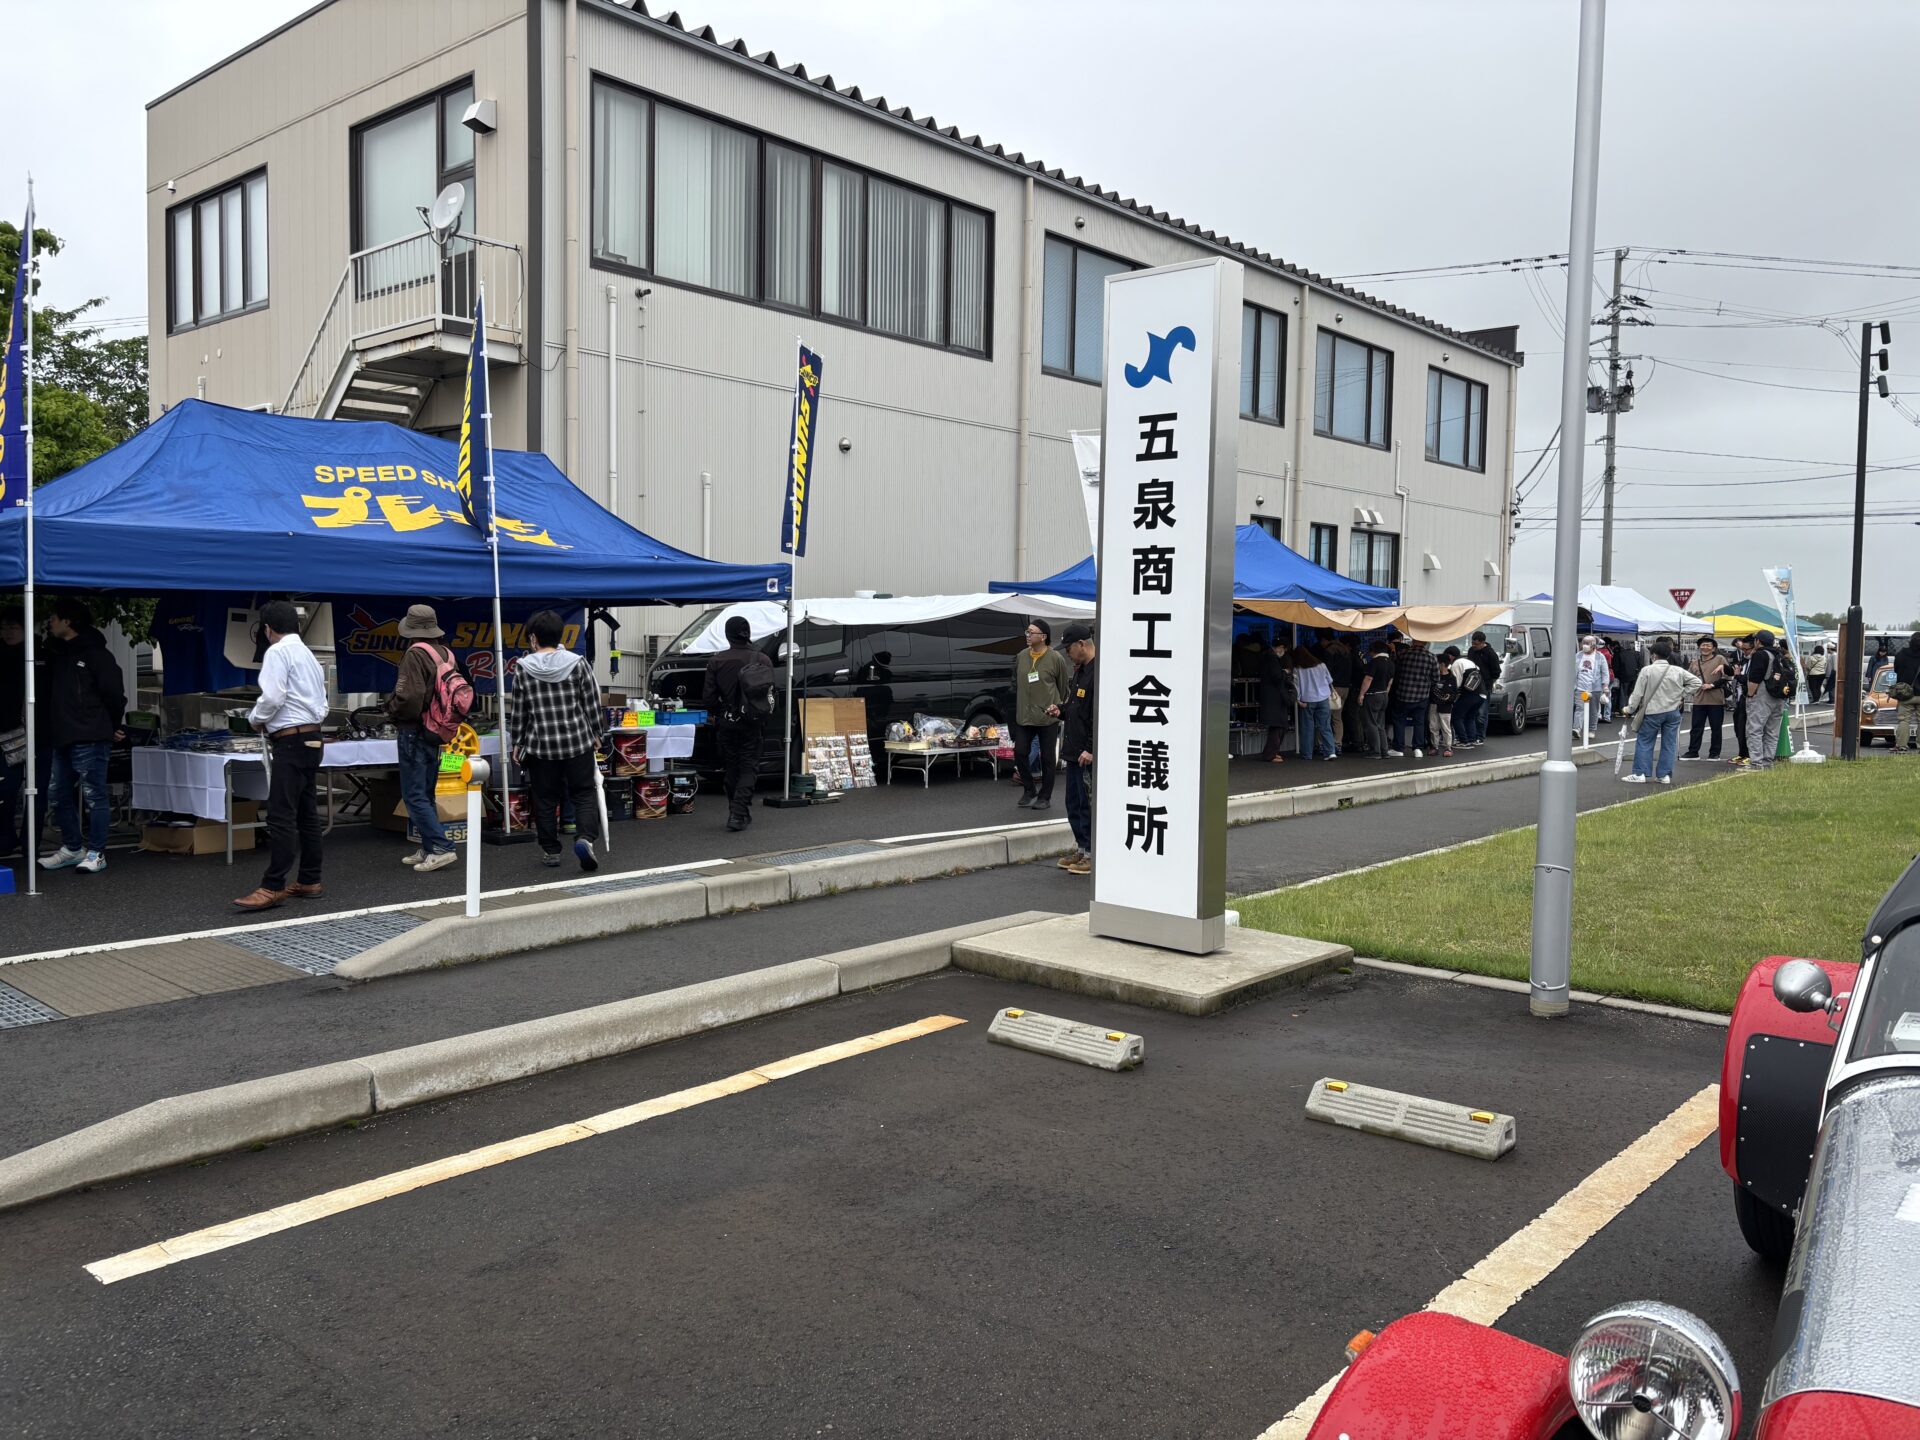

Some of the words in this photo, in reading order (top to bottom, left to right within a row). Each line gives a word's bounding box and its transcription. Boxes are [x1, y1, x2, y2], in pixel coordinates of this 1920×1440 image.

[315, 464, 417, 483] SPEED
[420, 469, 457, 493] SH
[1125, 412, 1178, 855] 五泉商工会議所
